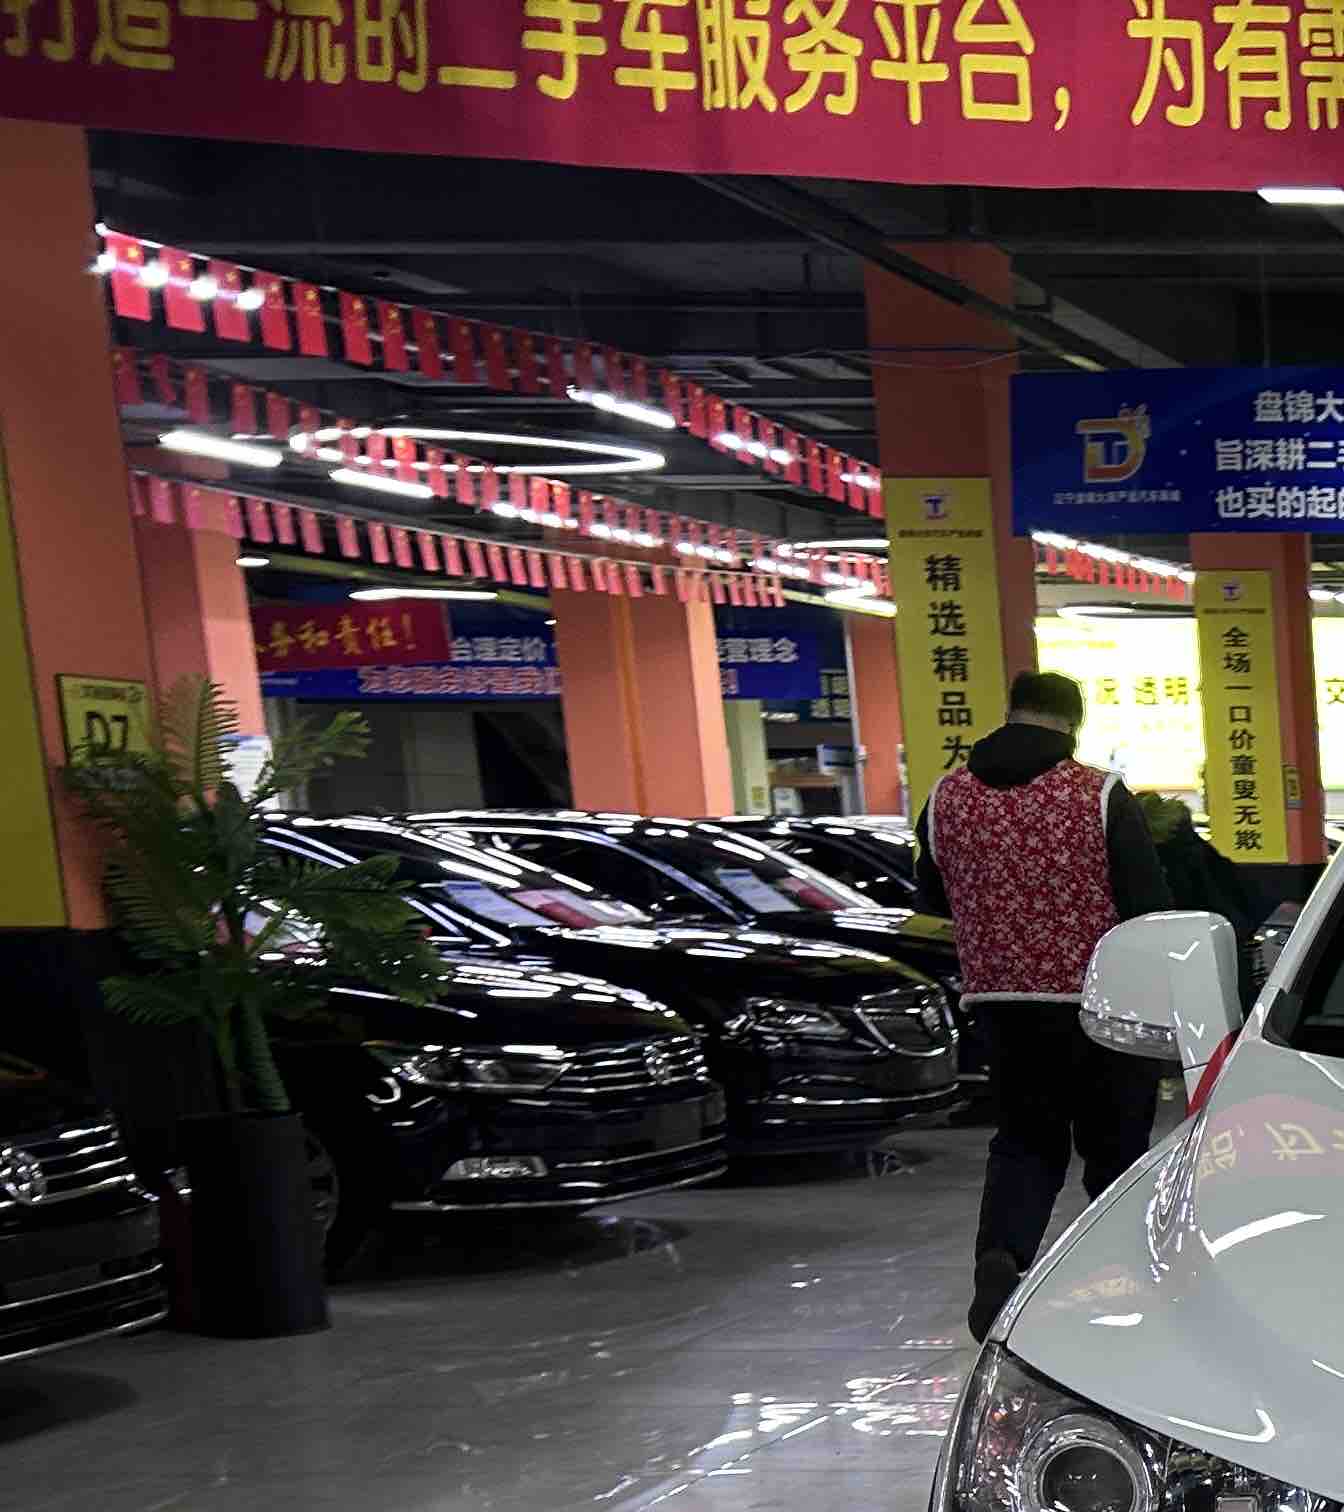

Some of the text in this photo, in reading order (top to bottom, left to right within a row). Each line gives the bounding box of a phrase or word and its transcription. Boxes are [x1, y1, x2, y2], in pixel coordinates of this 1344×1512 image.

[1221, 626, 1262, 850] 全场一口价童叟无欺
